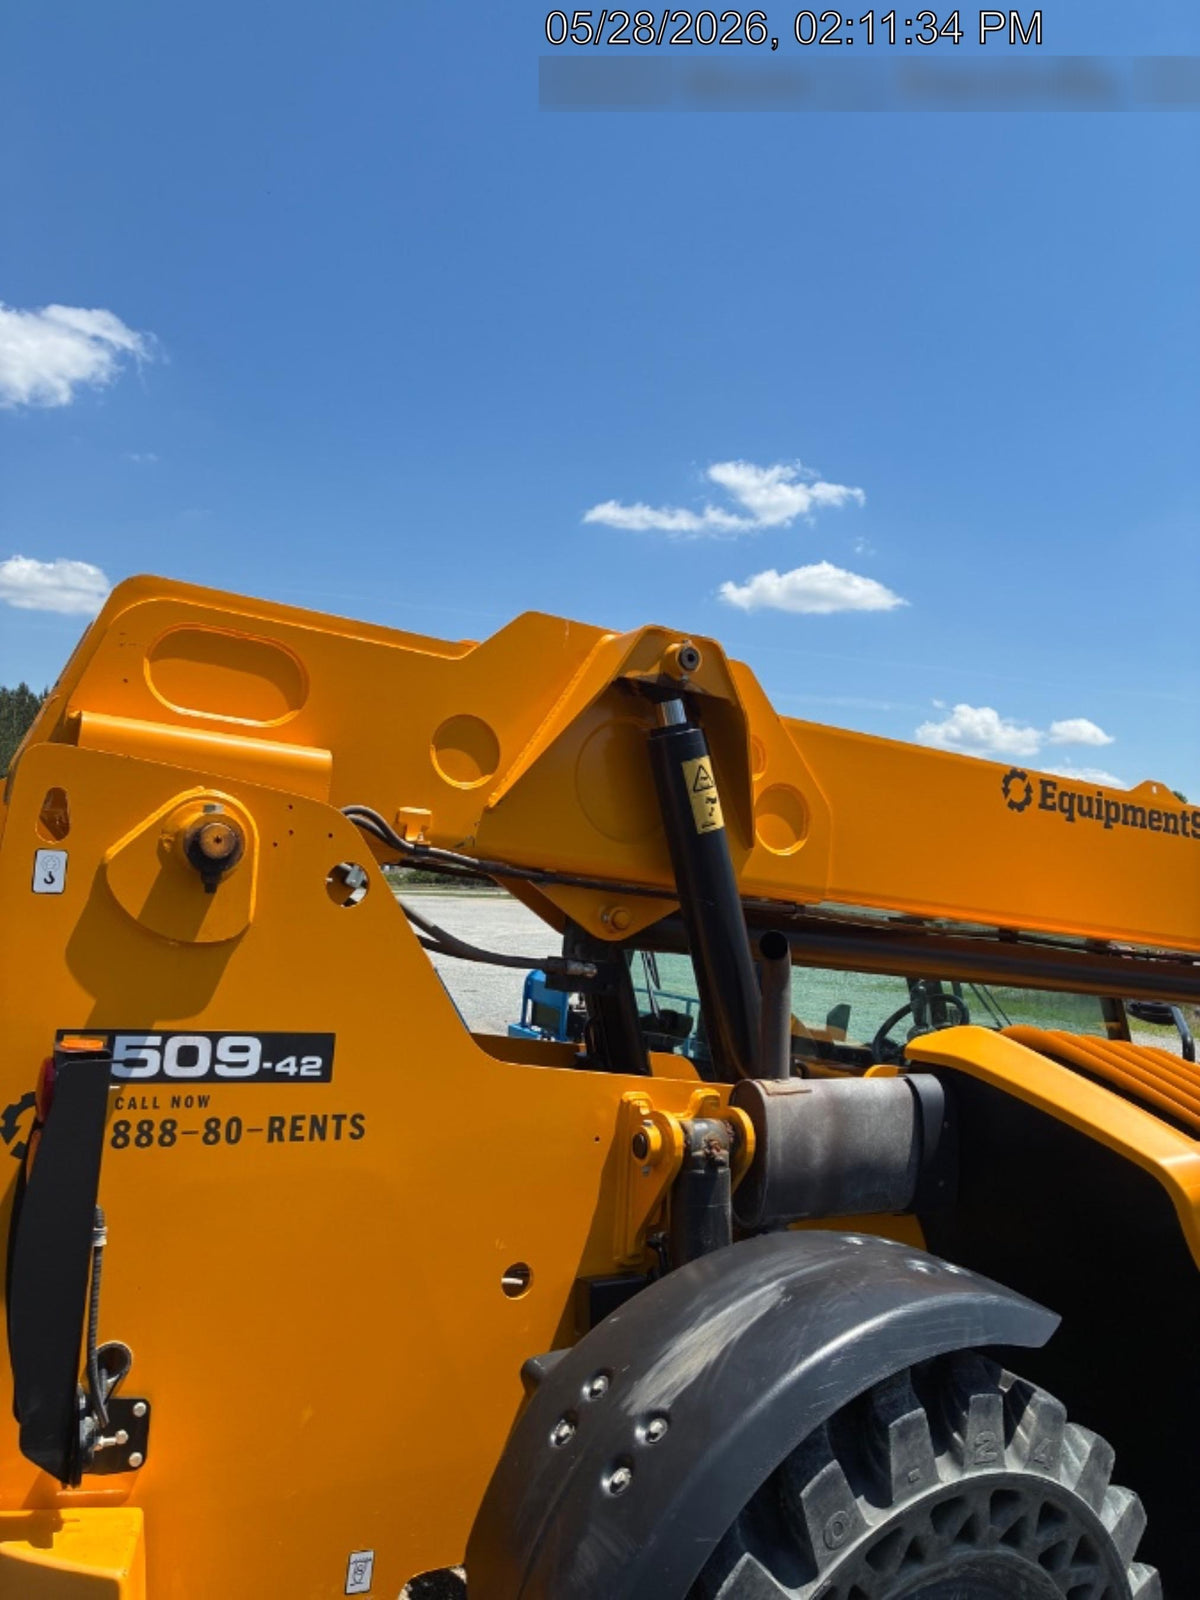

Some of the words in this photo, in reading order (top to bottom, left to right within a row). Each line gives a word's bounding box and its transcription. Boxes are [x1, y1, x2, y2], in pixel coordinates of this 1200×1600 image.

[111, 1035, 322, 1078] 509-42
[114, 1097, 160, 1110] CALL
[171, 1094, 211, 1109] NOW
[110, 1113, 366, 1149] 888-80-RENTS
